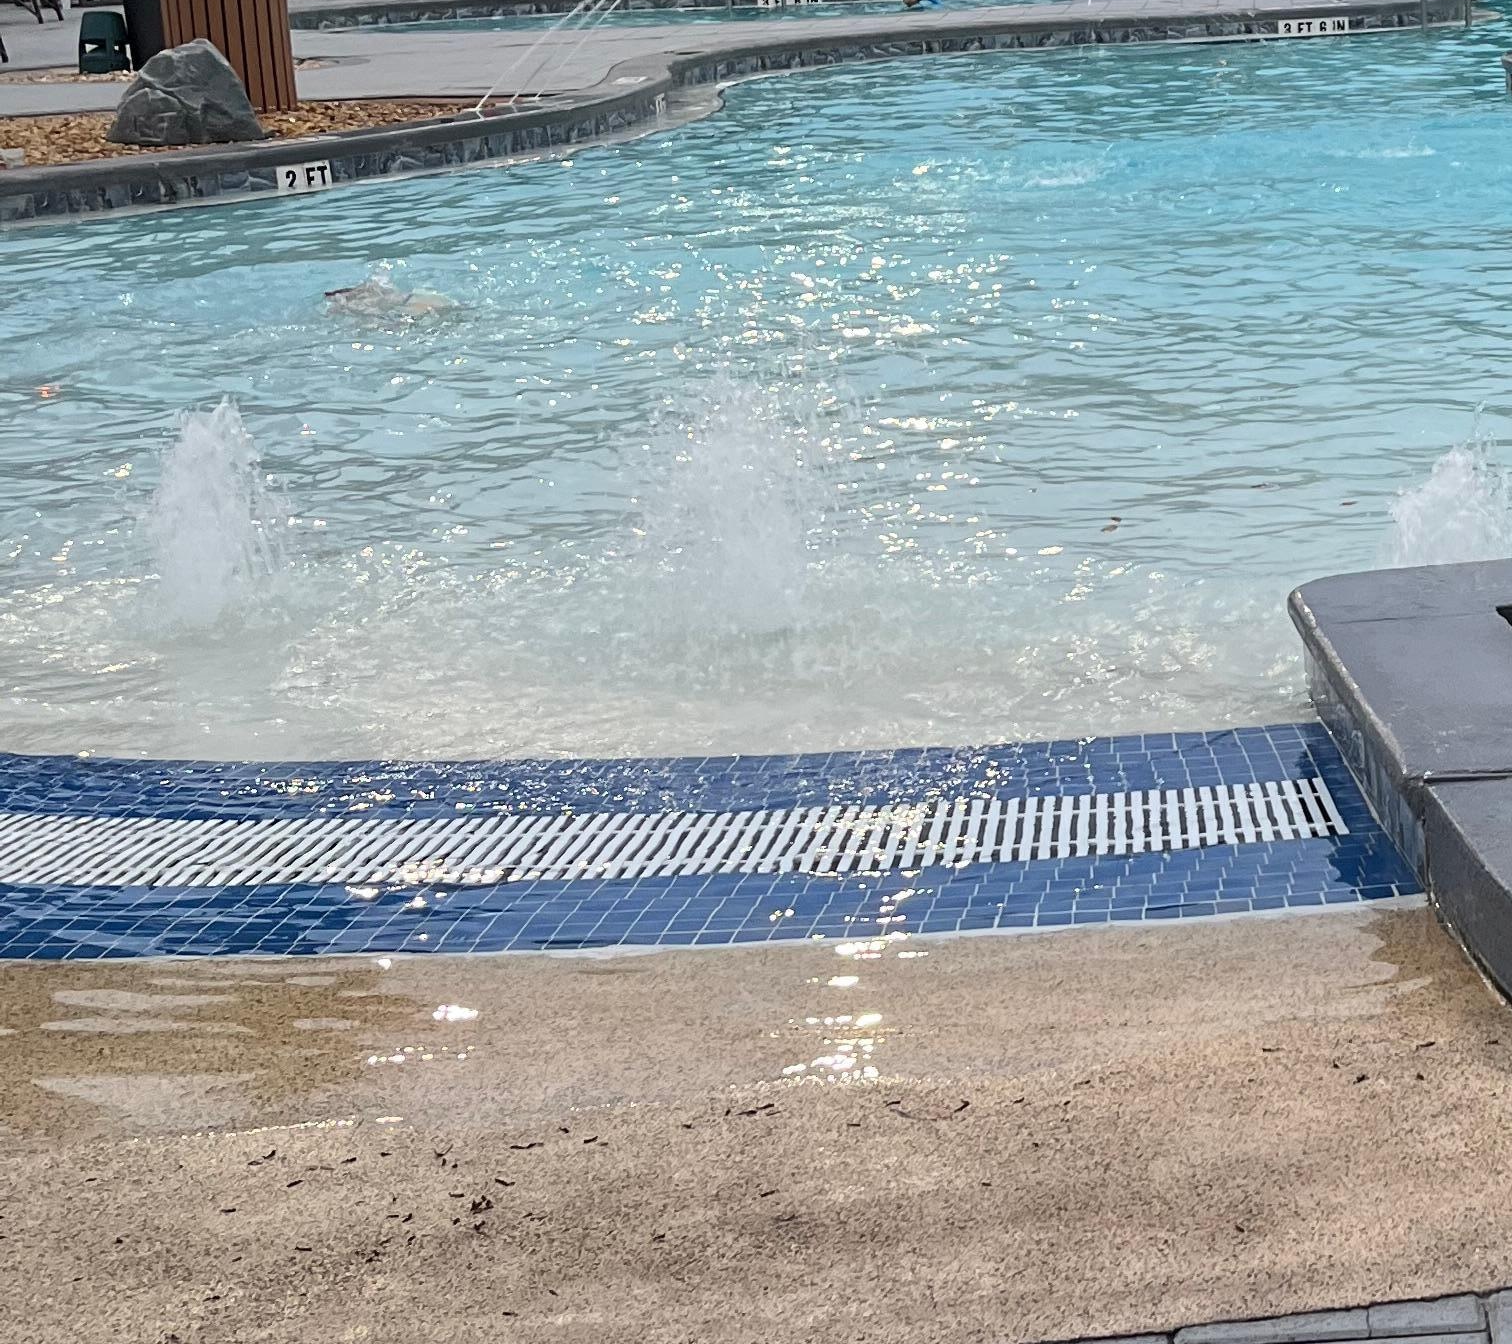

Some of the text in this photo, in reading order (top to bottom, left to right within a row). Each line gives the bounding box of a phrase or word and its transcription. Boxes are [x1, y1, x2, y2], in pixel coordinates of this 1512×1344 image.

[1297, 21, 1313, 33] FT
[1332, 19, 1345, 31] IN
[285, 165, 328, 188] 2 FT
